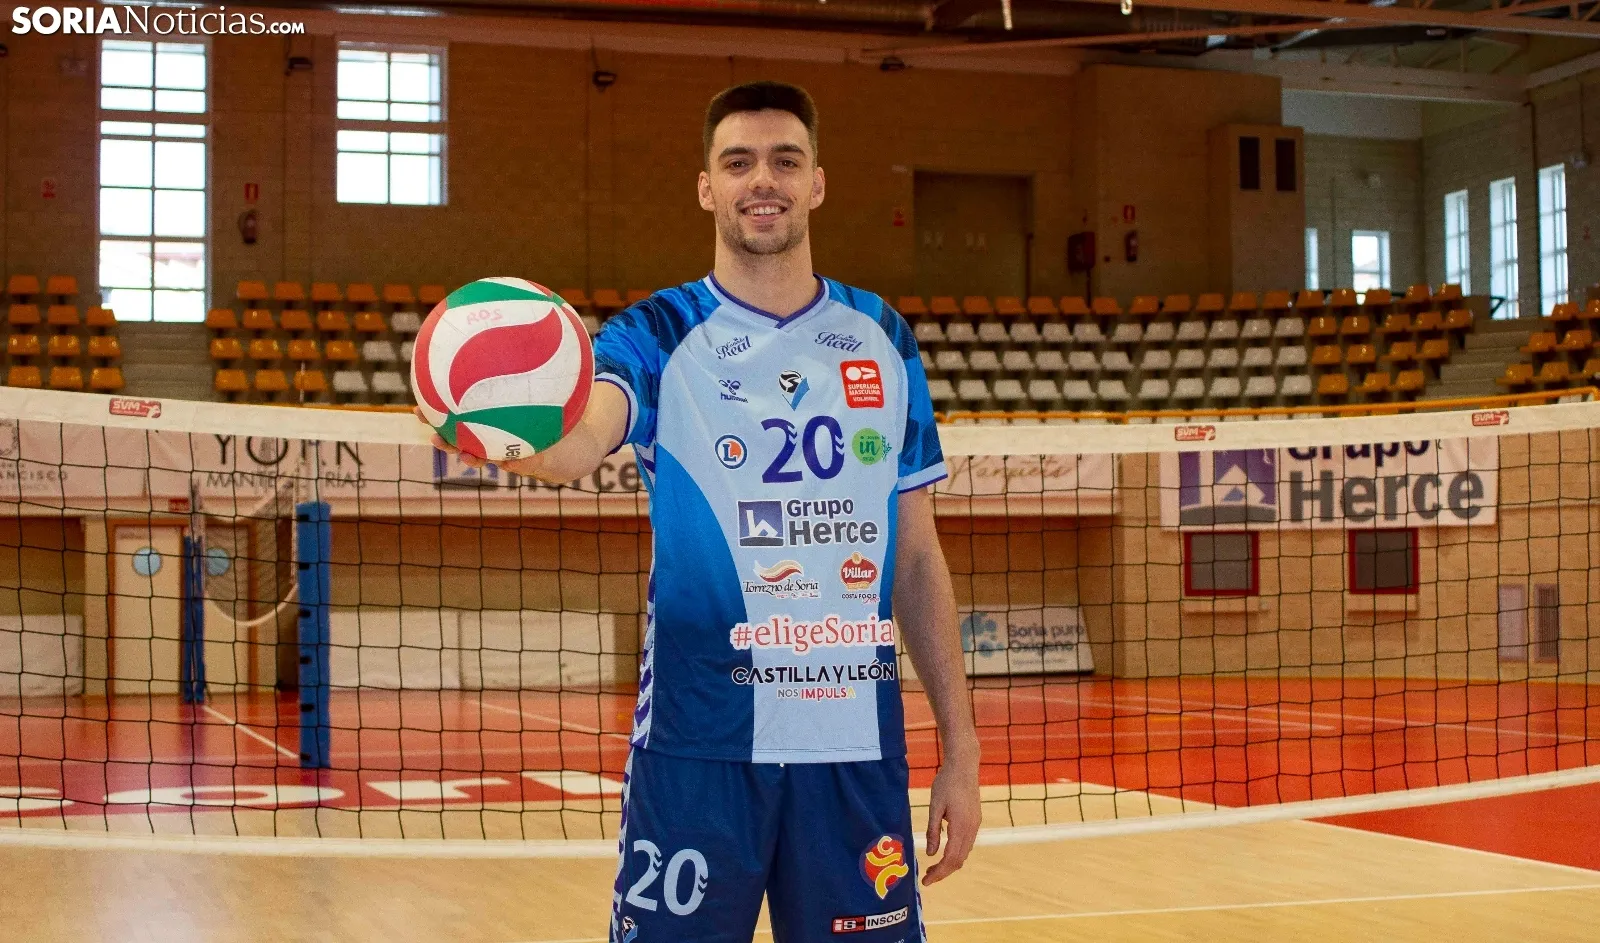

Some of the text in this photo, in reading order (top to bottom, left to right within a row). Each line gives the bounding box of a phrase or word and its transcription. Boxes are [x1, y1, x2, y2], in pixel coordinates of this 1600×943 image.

[715, 335, 752, 360] Real
[814, 331, 863, 352] Real
[760, 415, 845, 484] 20
[1289, 470, 1484, 522] Herce
[786, 499, 854, 519] Grupo
[788, 520, 878, 546] Herce
[842, 567, 875, 579] Villar
[743, 581, 783, 596] Torrezno
[784, 579, 794, 592] de
[795, 579, 818, 591] Soria
[733, 615, 893, 652] #eligeSoria
[732, 659, 894, 684] CASTILLA Y LEÓN
[778, 687, 856, 701] NOS IMPULSA
[625, 839, 709, 916] 20
[867, 910, 906, 927] INSOCA
